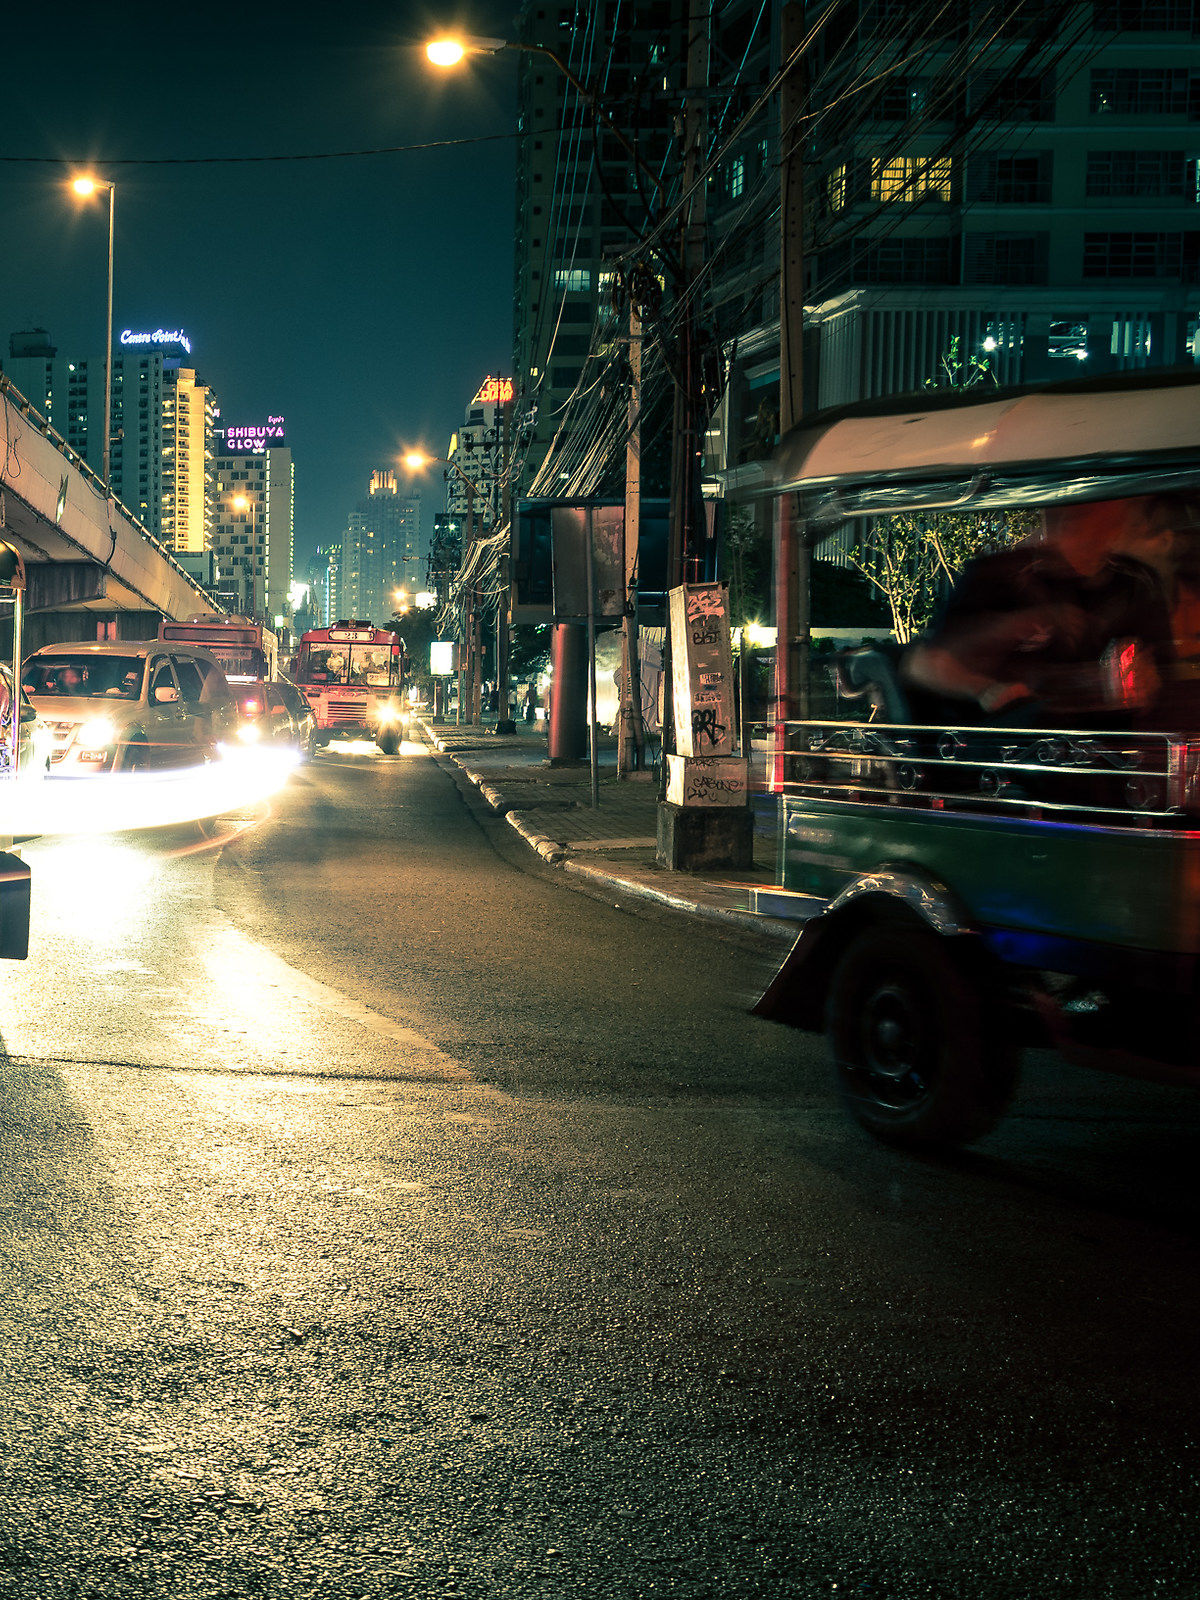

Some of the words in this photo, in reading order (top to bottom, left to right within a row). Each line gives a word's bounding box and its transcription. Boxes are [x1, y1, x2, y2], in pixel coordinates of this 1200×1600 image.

[486, 381, 513, 391] GRA
[227, 426, 284, 438] SHIBUYA
[227, 438, 266, 449] GLOW
